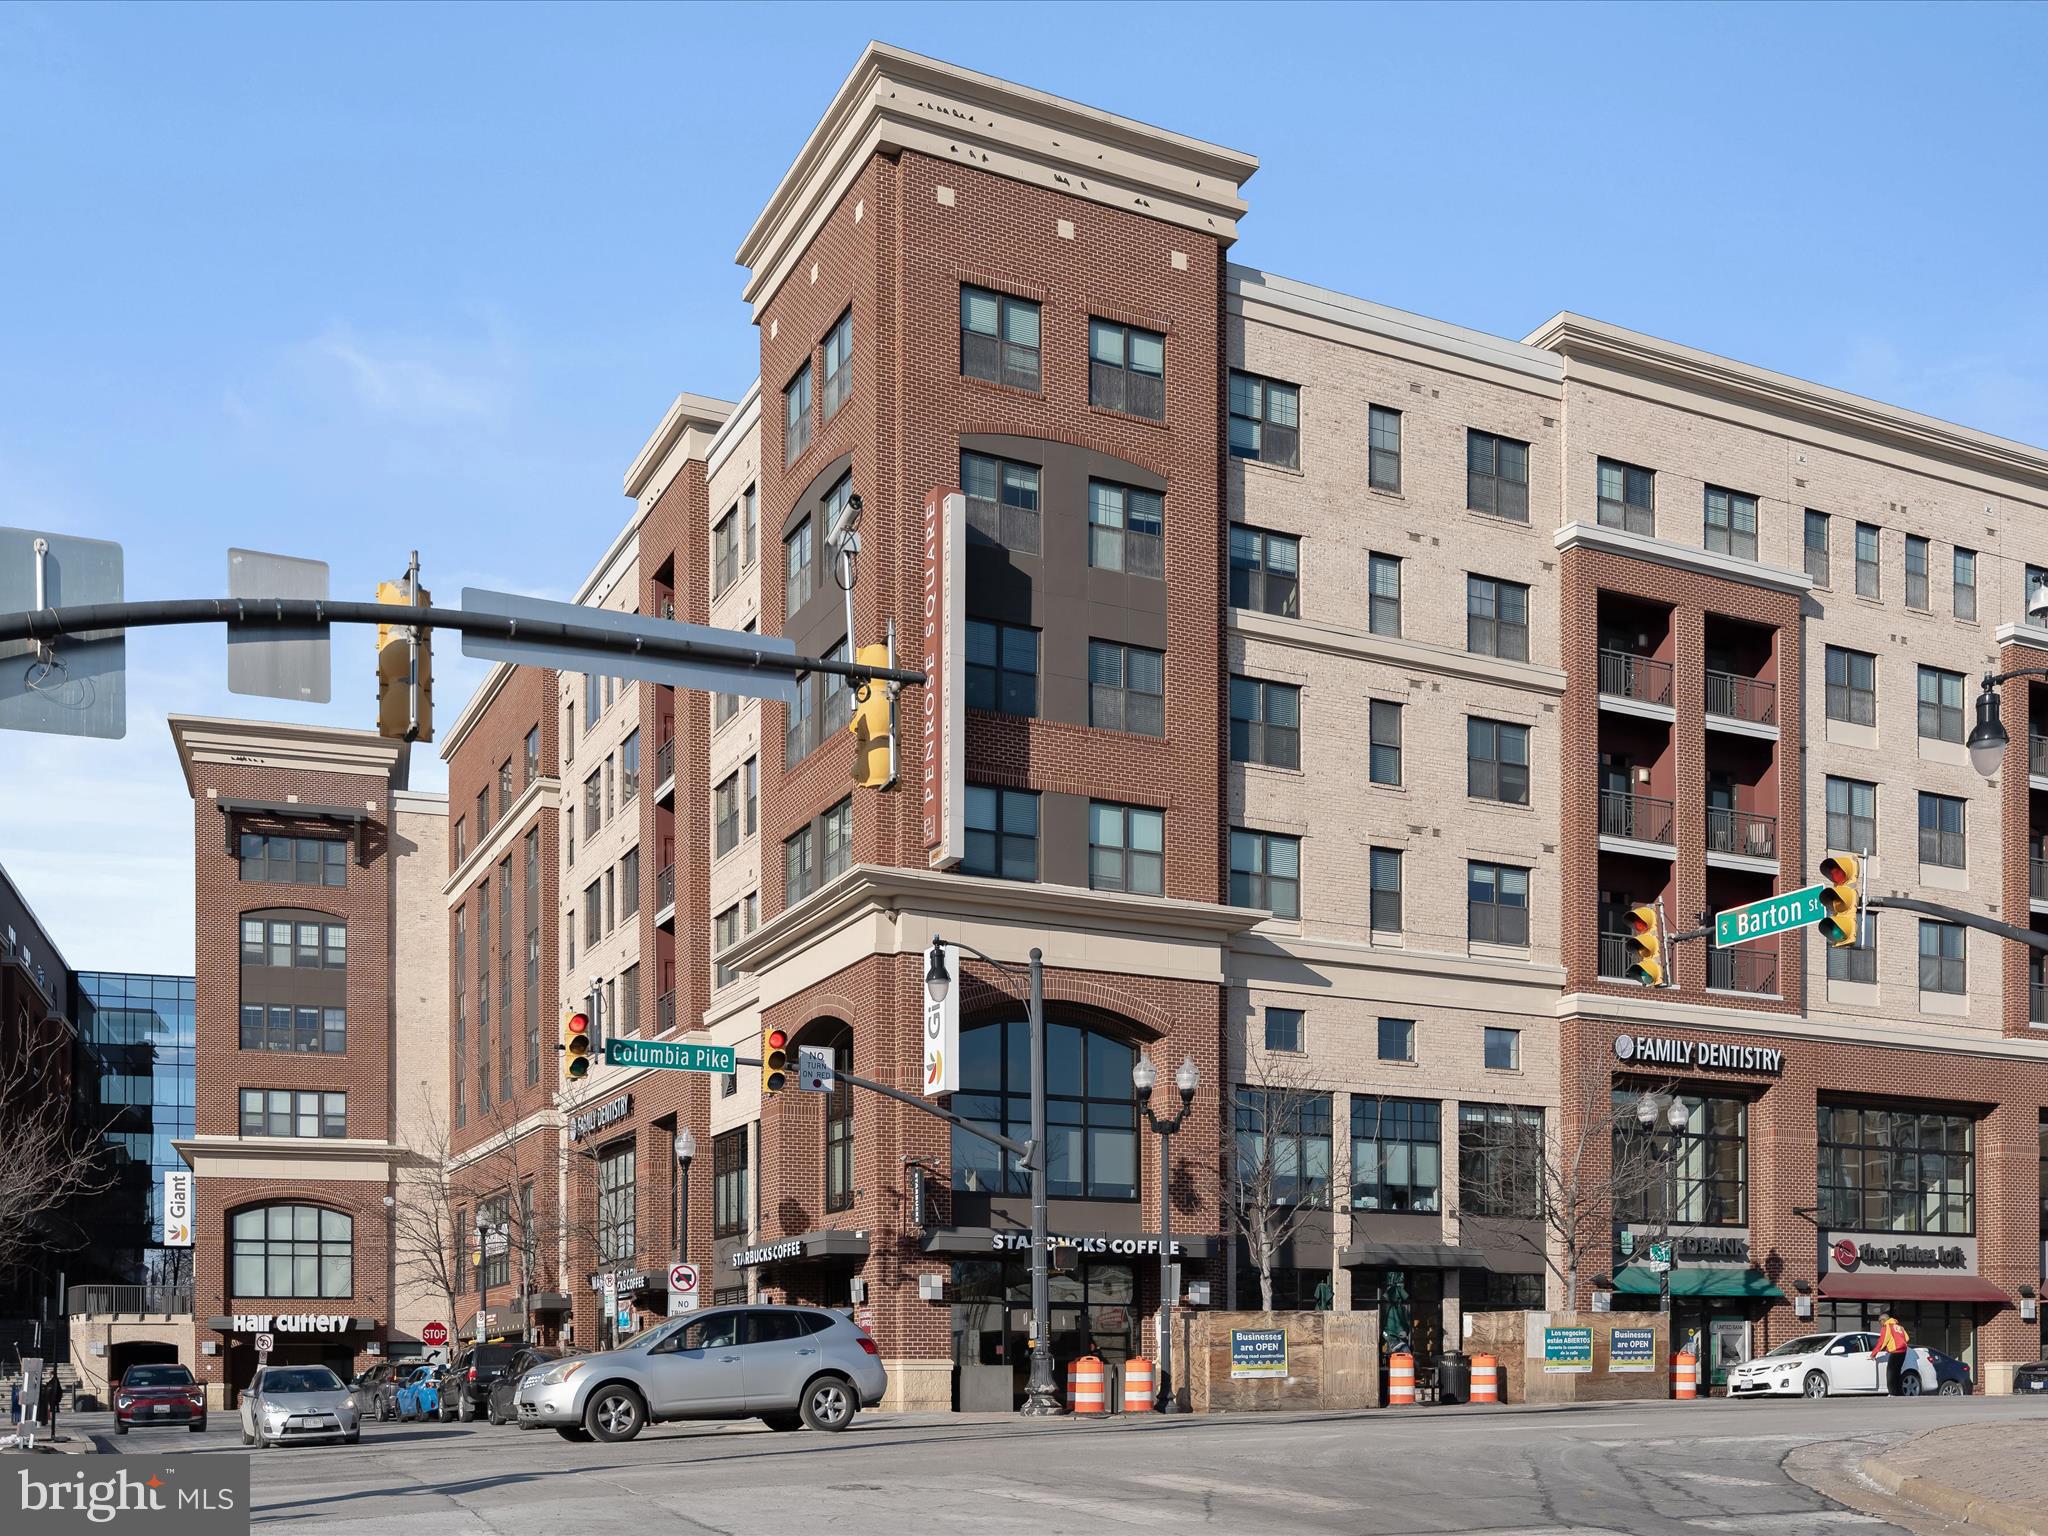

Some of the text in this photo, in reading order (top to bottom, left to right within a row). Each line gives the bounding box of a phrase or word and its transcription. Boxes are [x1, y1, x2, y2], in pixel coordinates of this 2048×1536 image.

[925, 501, 936, 803] PENROSE SQUARE
[1721, 900, 1819, 937] S Barton St
[612, 1044, 730, 1069] Columbia Pike
[809, 1051, 824, 1061] NO
[1636, 1037, 1782, 1071] FAMILY DENTISTRY
[807, 1062, 827, 1070] TURN
[802, 1070, 831, 1080] ON RED
[597, 1093, 629, 1127] DENTISTRY
[170, 1175, 186, 1219] Giant
[992, 1233, 1180, 1255] STABCKS COFFE
[1701, 1238, 1745, 1255] BANK
[732, 1240, 801, 1267] STARBUCKS COFFEE
[1860, 1242, 1965, 1265] the pilates loft
[677, 1300, 690, 1308] NO
[233, 1314, 273, 1332] Hair
[424, 1329, 447, 1339] STOP
[1236, 1332, 1282, 1341] Businesses
[1562, 1330, 1587, 1338] negocios
[1614, 1331, 1652, 1339] Businesses
[1255, 1343, 1279, 1351] OPEN
[1629, 1340, 1649, 1348] OPEN
